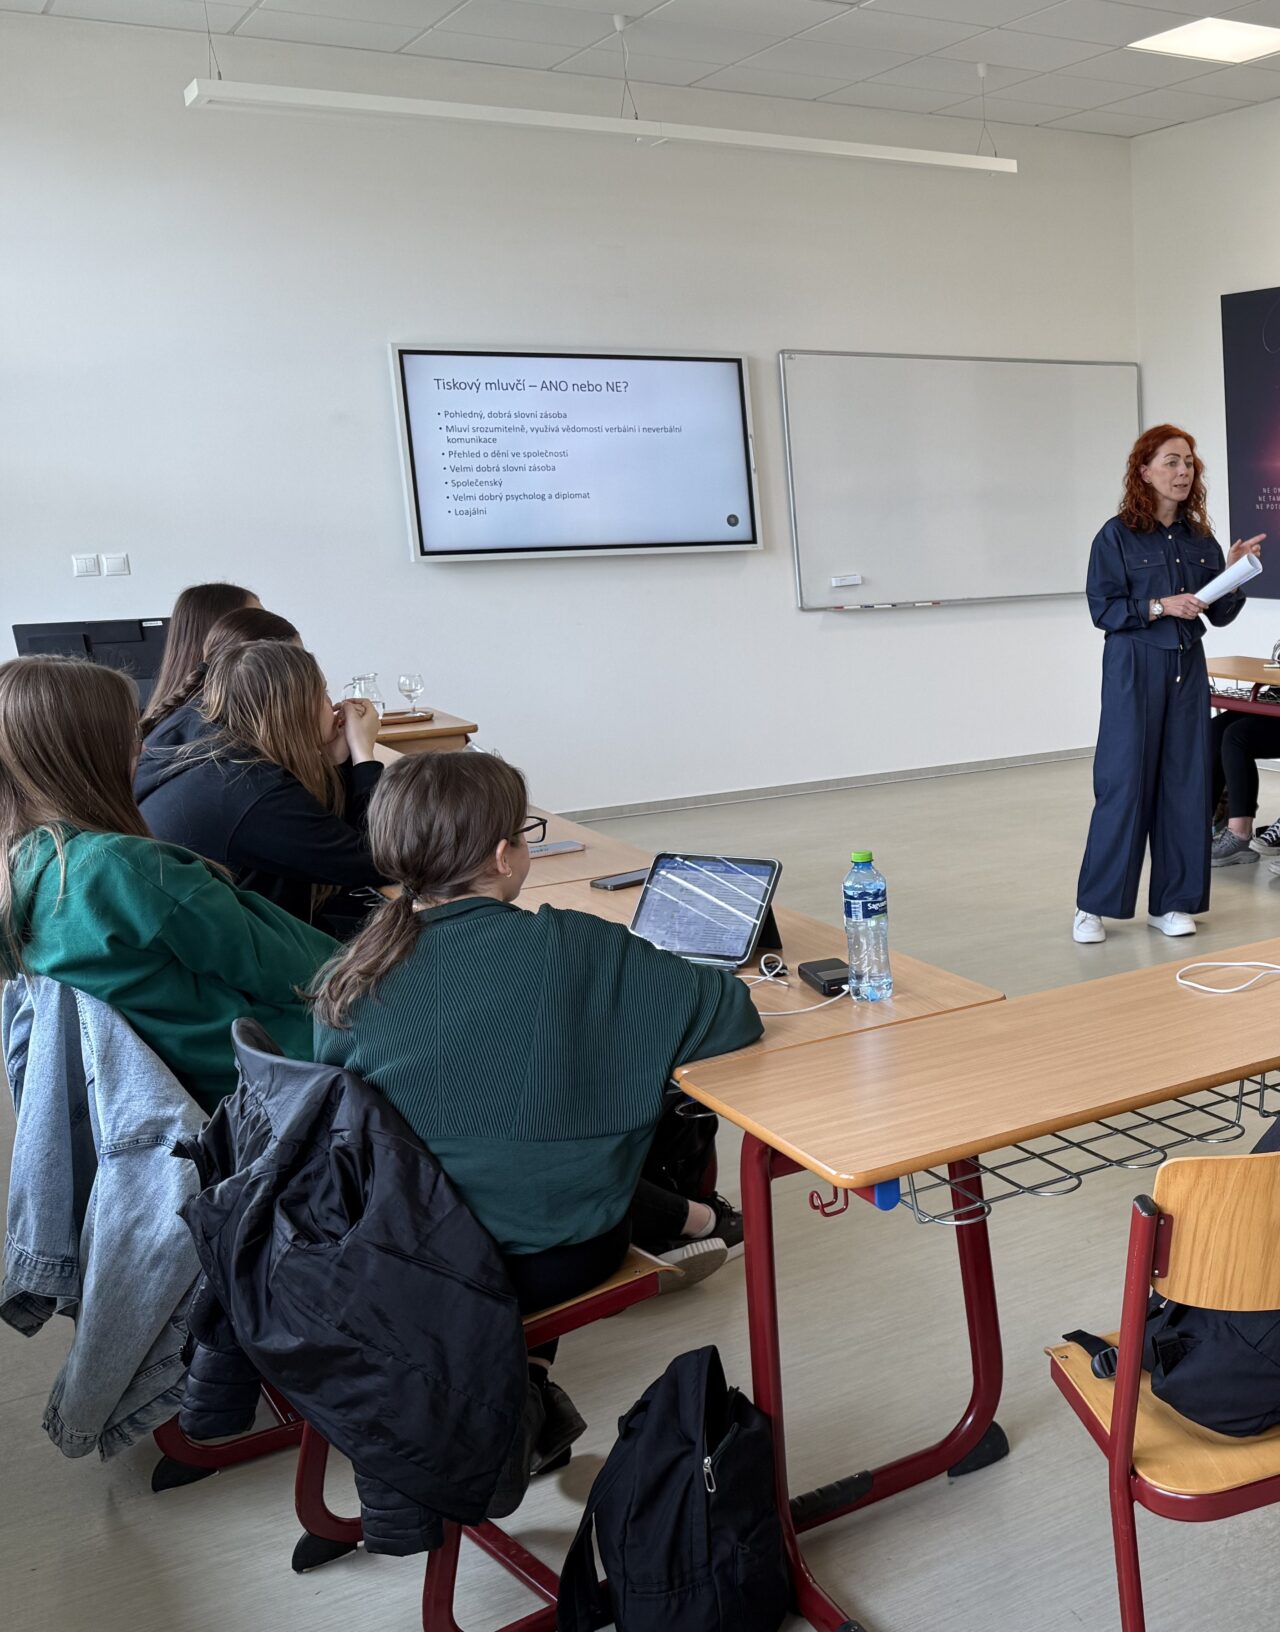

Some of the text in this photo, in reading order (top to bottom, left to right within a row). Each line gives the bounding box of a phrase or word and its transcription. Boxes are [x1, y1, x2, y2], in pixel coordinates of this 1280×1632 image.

[433, 377, 481, 394] Tiskový
[485, 378, 526, 392] mluvčí
[540, 381, 569, 393] ANO
[572, 381, 603, 393] nebo
[606, 381, 629, 393] NE?
[444, 410, 568, 421] Pohledný, dobrá slovní zásoba
[446, 424, 470, 433] Mluví
[471, 425, 528, 434] srozumitelně,
[530, 424, 560, 435] využívá
[604, 425, 637, 433] verbální
[642, 425, 682, 433] neverbální
[446, 435, 497, 445] komunikace
[448, 449, 481, 459] Přehled
[491, 448, 508, 458] dění
[450, 463, 556, 473] Velmi dobrá slovní zásoba
[451, 477, 503, 489] Společenský
[453, 492, 477, 502] Velmi
[479, 492, 504, 502] dobrý
[505, 492, 546, 502] psycholog
[554, 491, 590, 500] diplomat
[454, 507, 487, 518] Loajální
